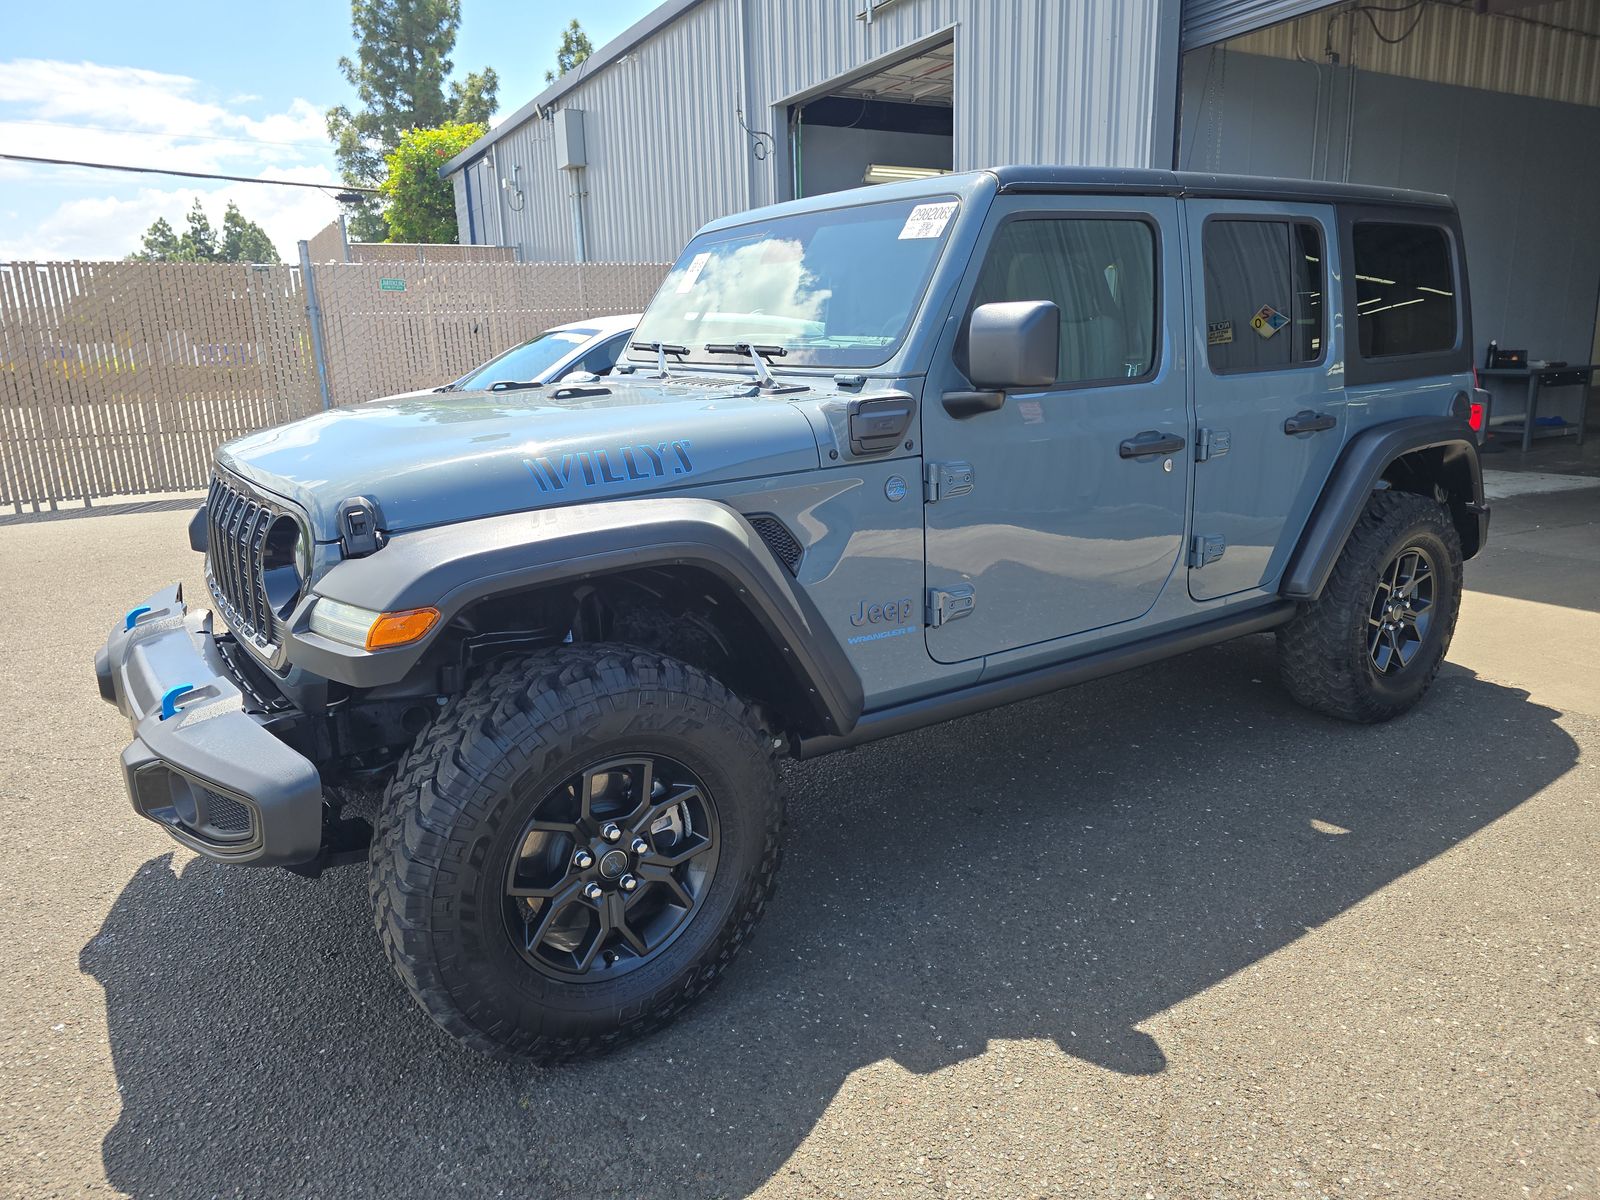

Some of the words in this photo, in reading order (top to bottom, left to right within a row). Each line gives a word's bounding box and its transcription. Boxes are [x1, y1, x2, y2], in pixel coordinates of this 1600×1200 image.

[522, 439, 693, 493] WILLYS
[849, 599, 913, 627] Jeep
[847, 628, 906, 645] WRANGLER
